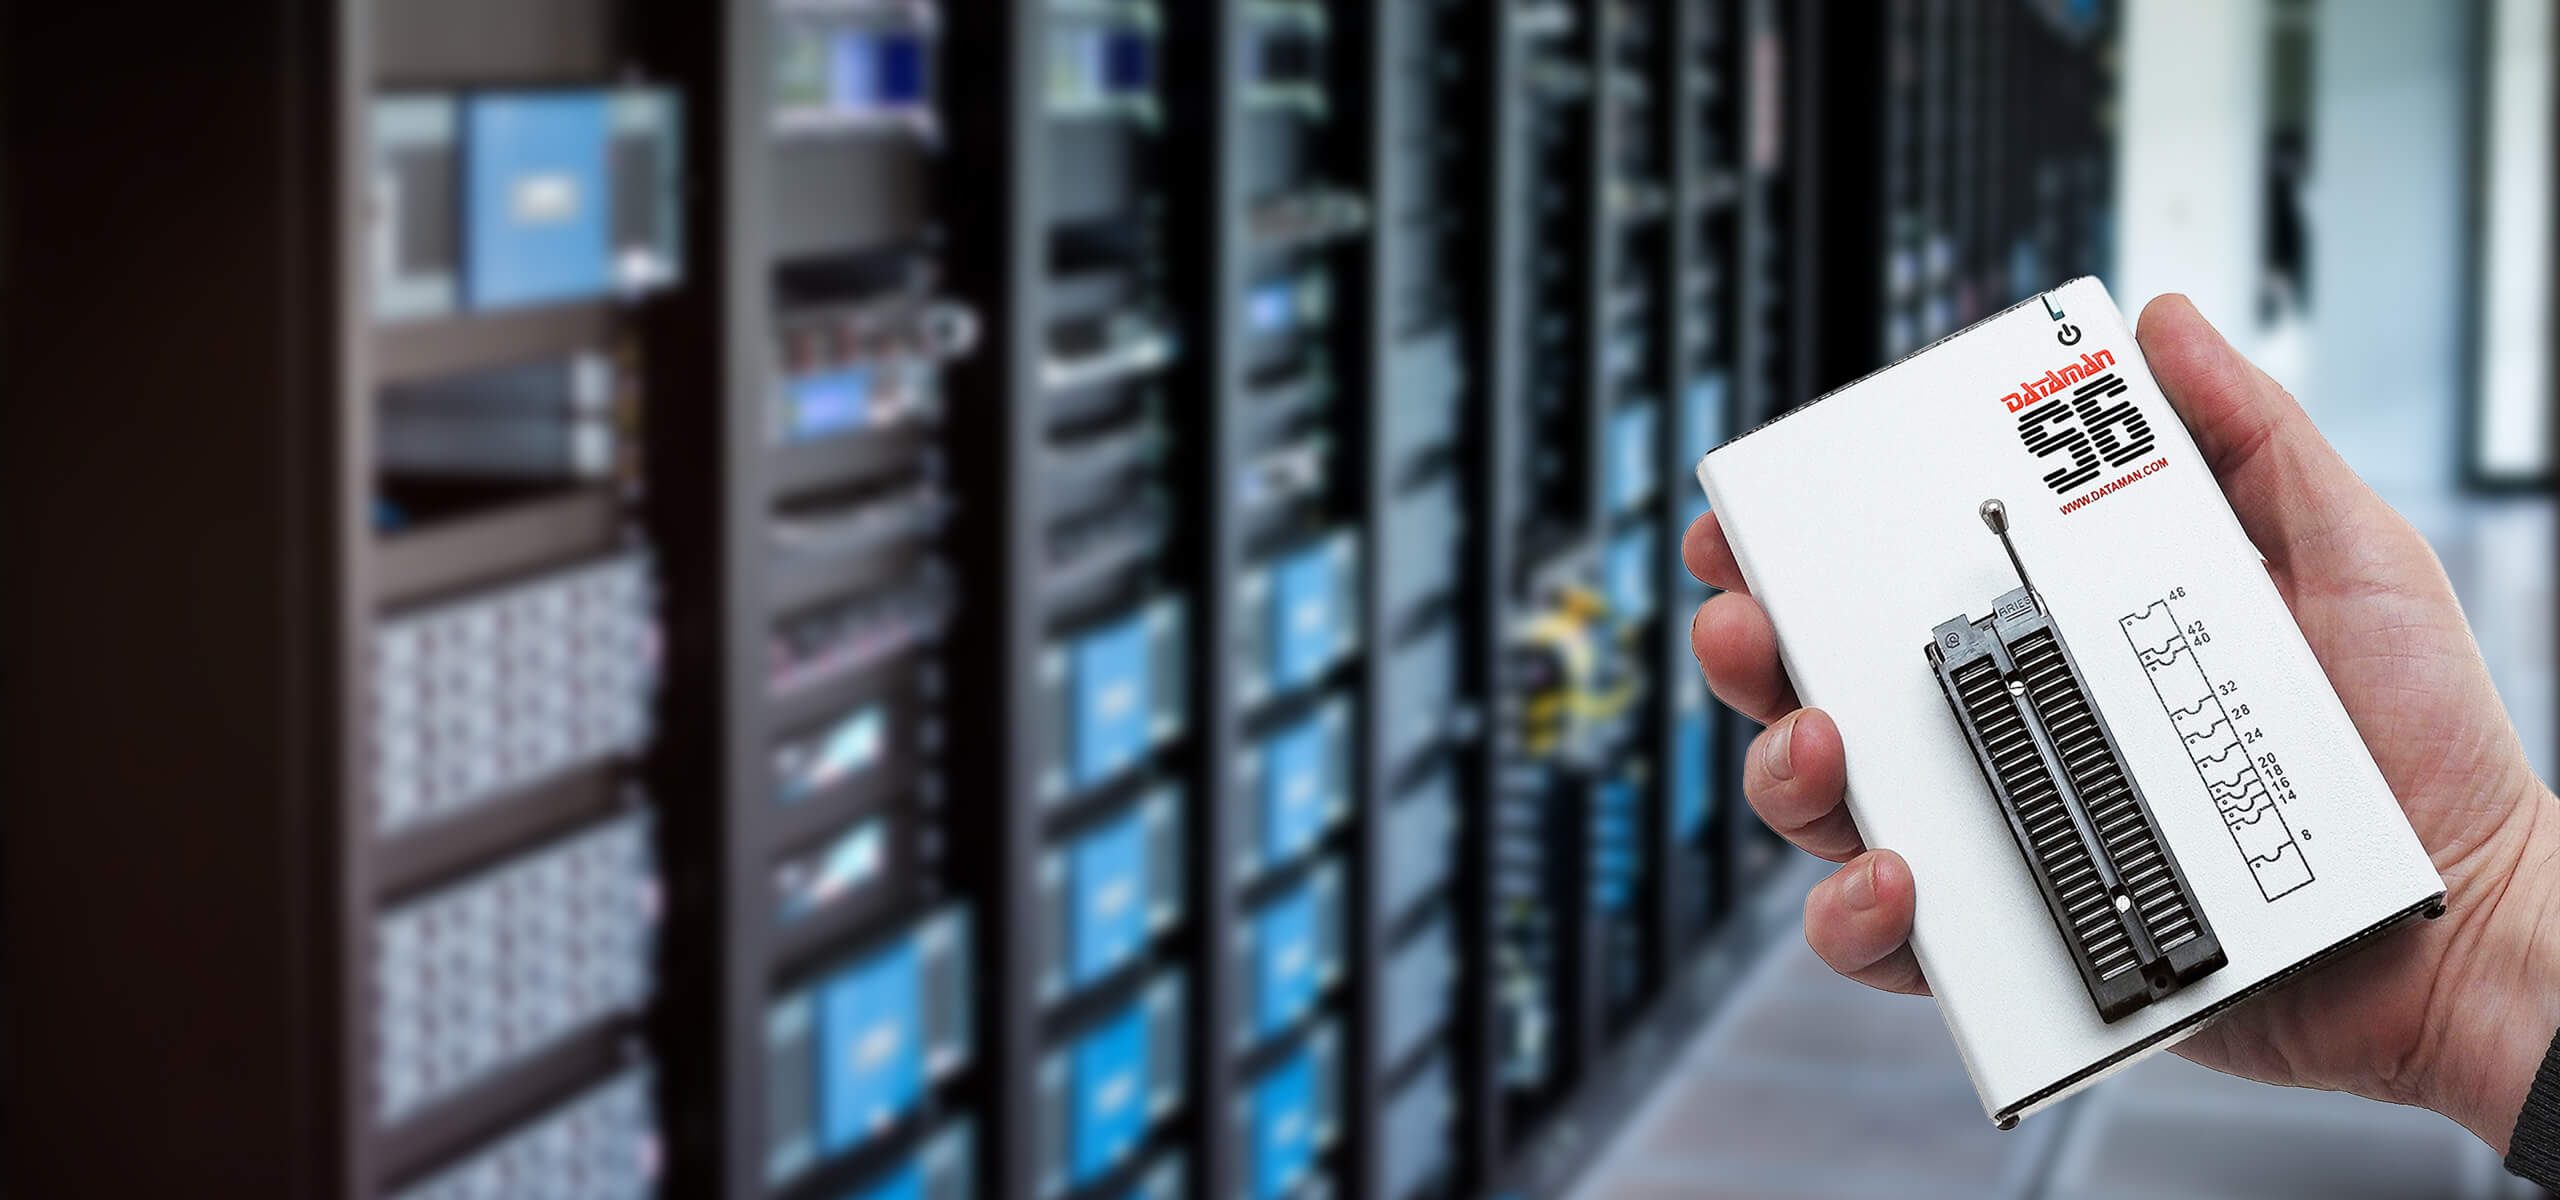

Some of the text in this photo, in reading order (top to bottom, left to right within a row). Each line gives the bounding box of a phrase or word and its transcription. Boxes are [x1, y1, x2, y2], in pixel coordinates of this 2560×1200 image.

[2000, 349, 2116, 414] DATAMAN
[2017, 373, 2155, 495] S6
[2059, 457, 2169, 516] WWW.DATAMAN.COM
[2169, 586, 2186, 601] 48
[1999, 595, 2032, 617] ARIES
[2187, 620, 2205, 635] 42
[2193, 632, 2211, 647] 40
[2218, 680, 2238, 696] 32
[2231, 704, 2251, 720] 28
[2244, 727, 2263, 744] 24
[2257, 752, 2276, 769] 20
[2265, 764, 2283, 780] 18
[2271, 777, 2290, 792] 16
[2278, 790, 2297, 805] 14
[2301, 828, 2312, 841] 8
